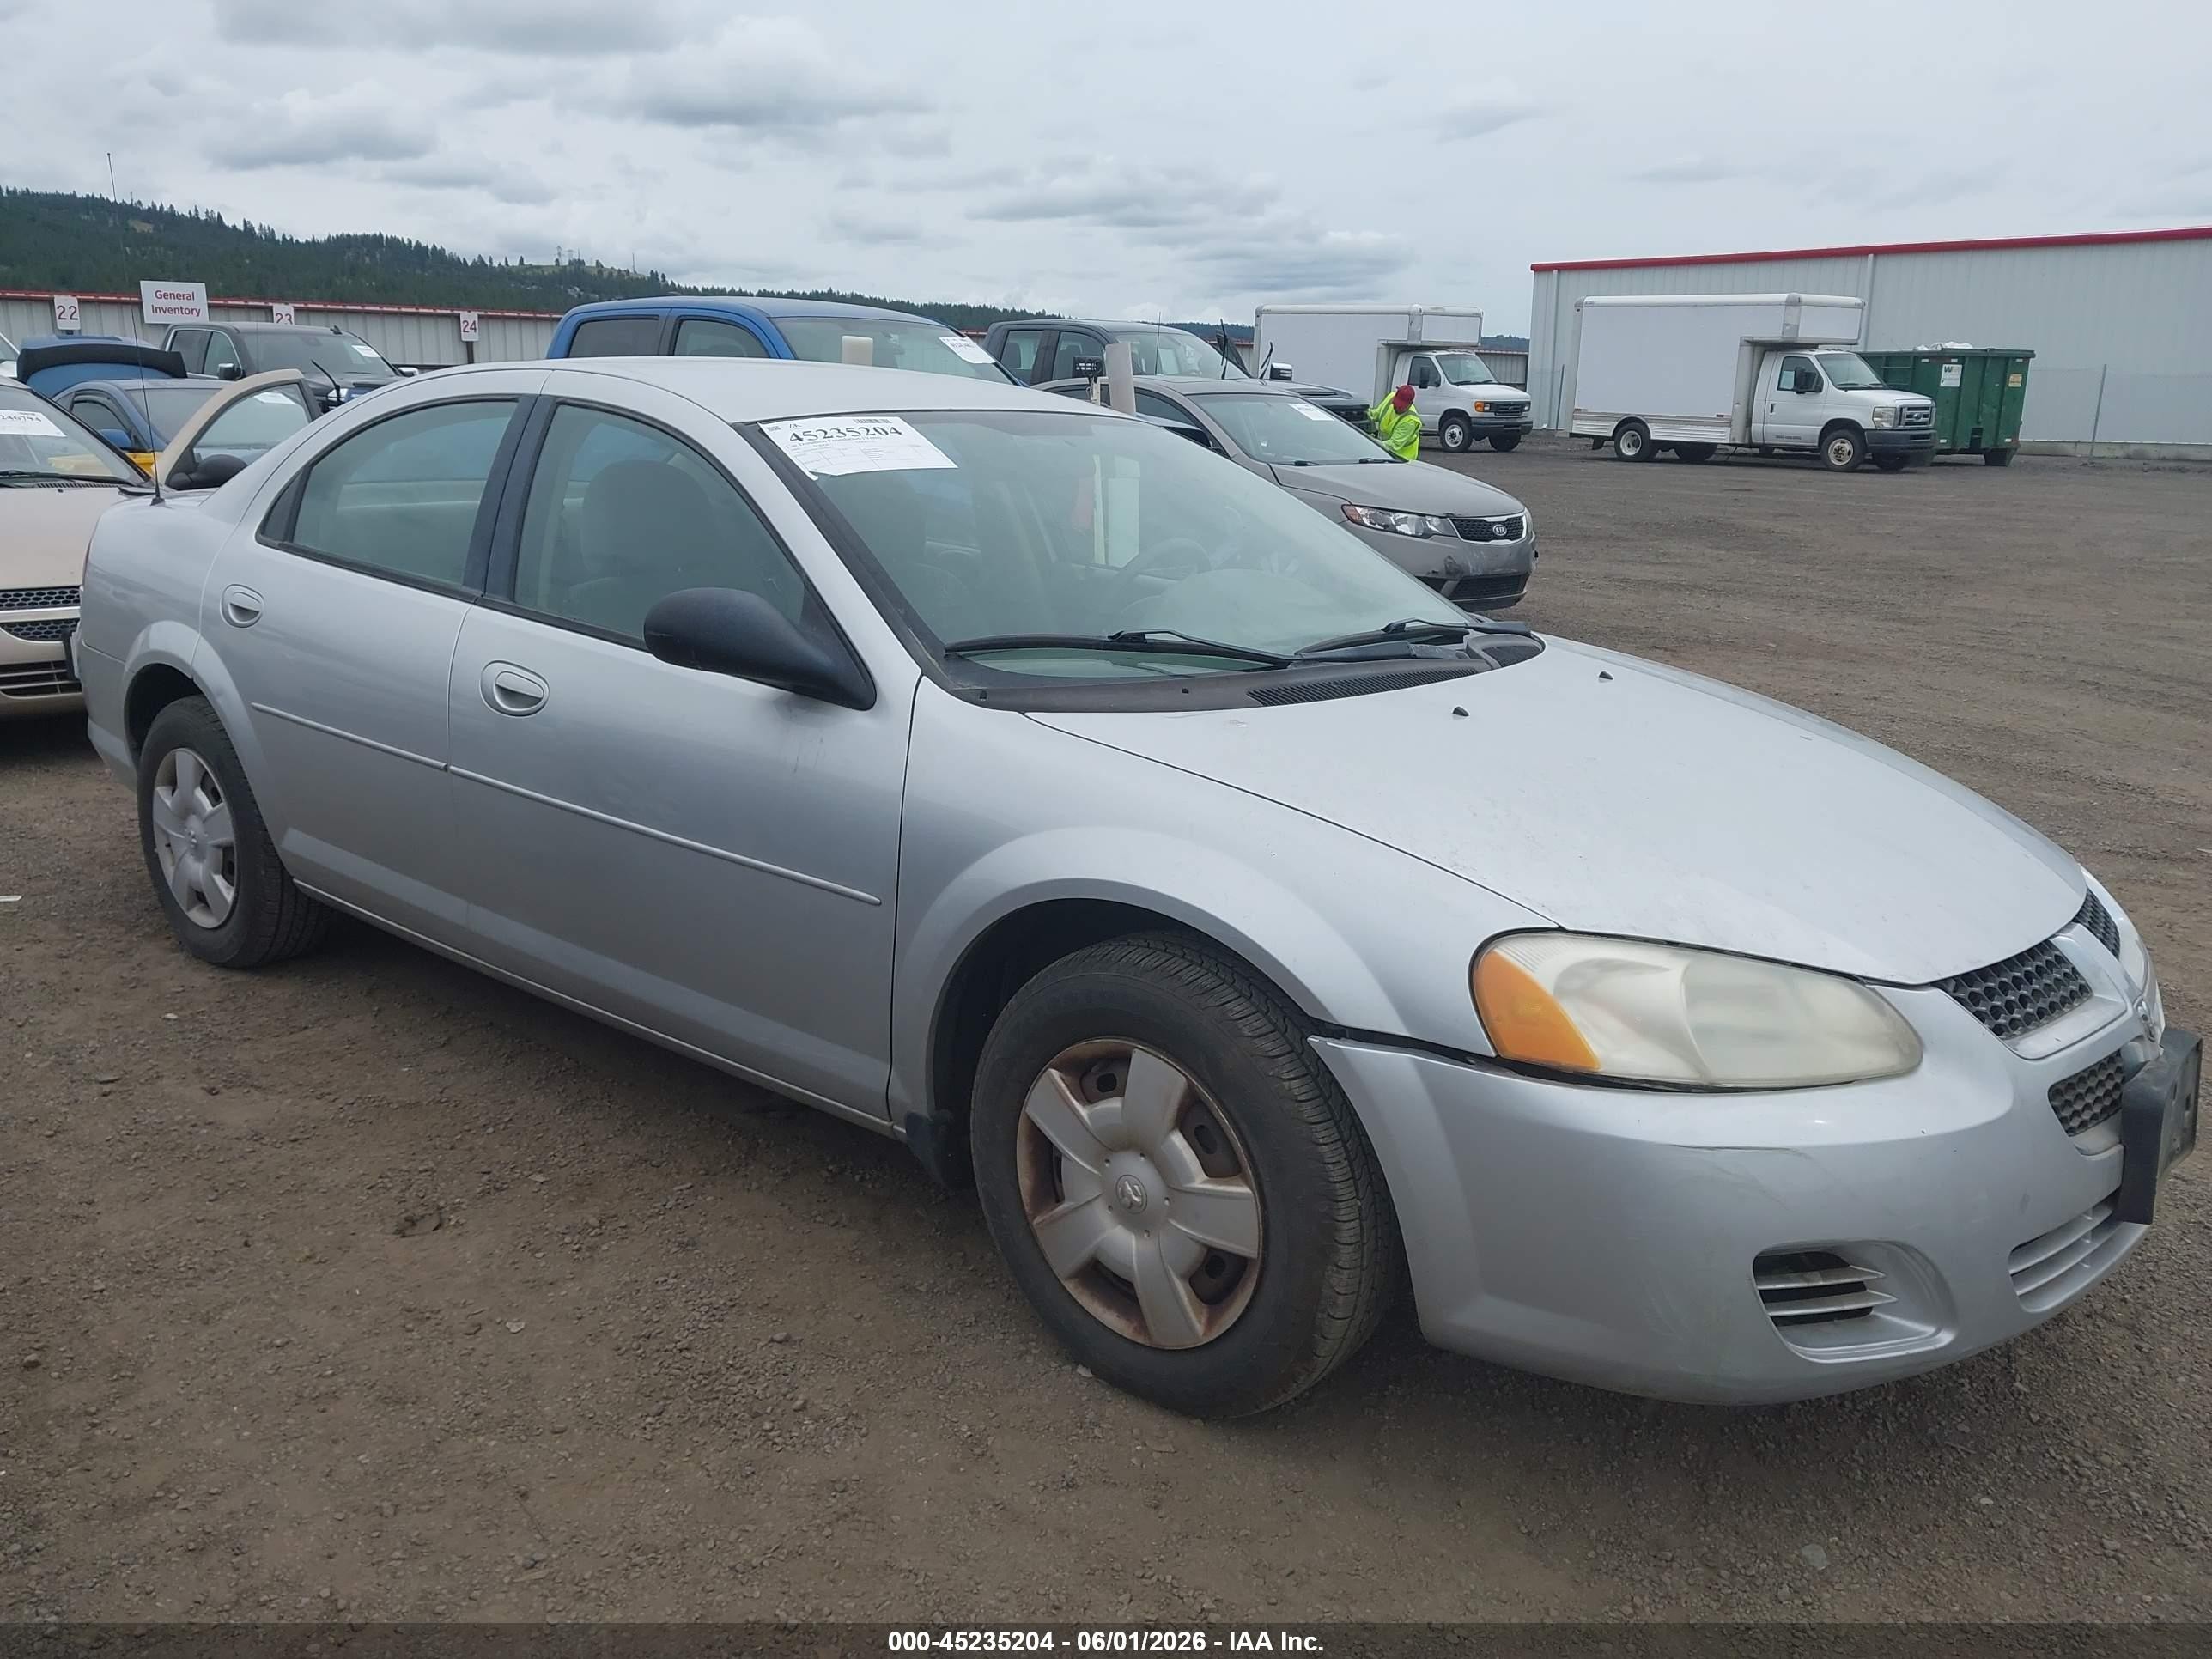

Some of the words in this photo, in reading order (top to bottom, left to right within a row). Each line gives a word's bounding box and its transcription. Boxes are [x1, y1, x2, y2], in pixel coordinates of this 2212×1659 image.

[155, 289, 195, 301] General
[57, 305, 79, 320] 22
[151, 304, 201, 317] Inventory
[276, 312, 293, 325] 23
[462, 319, 477, 333] 24
[789, 426, 902, 442] 45235204
